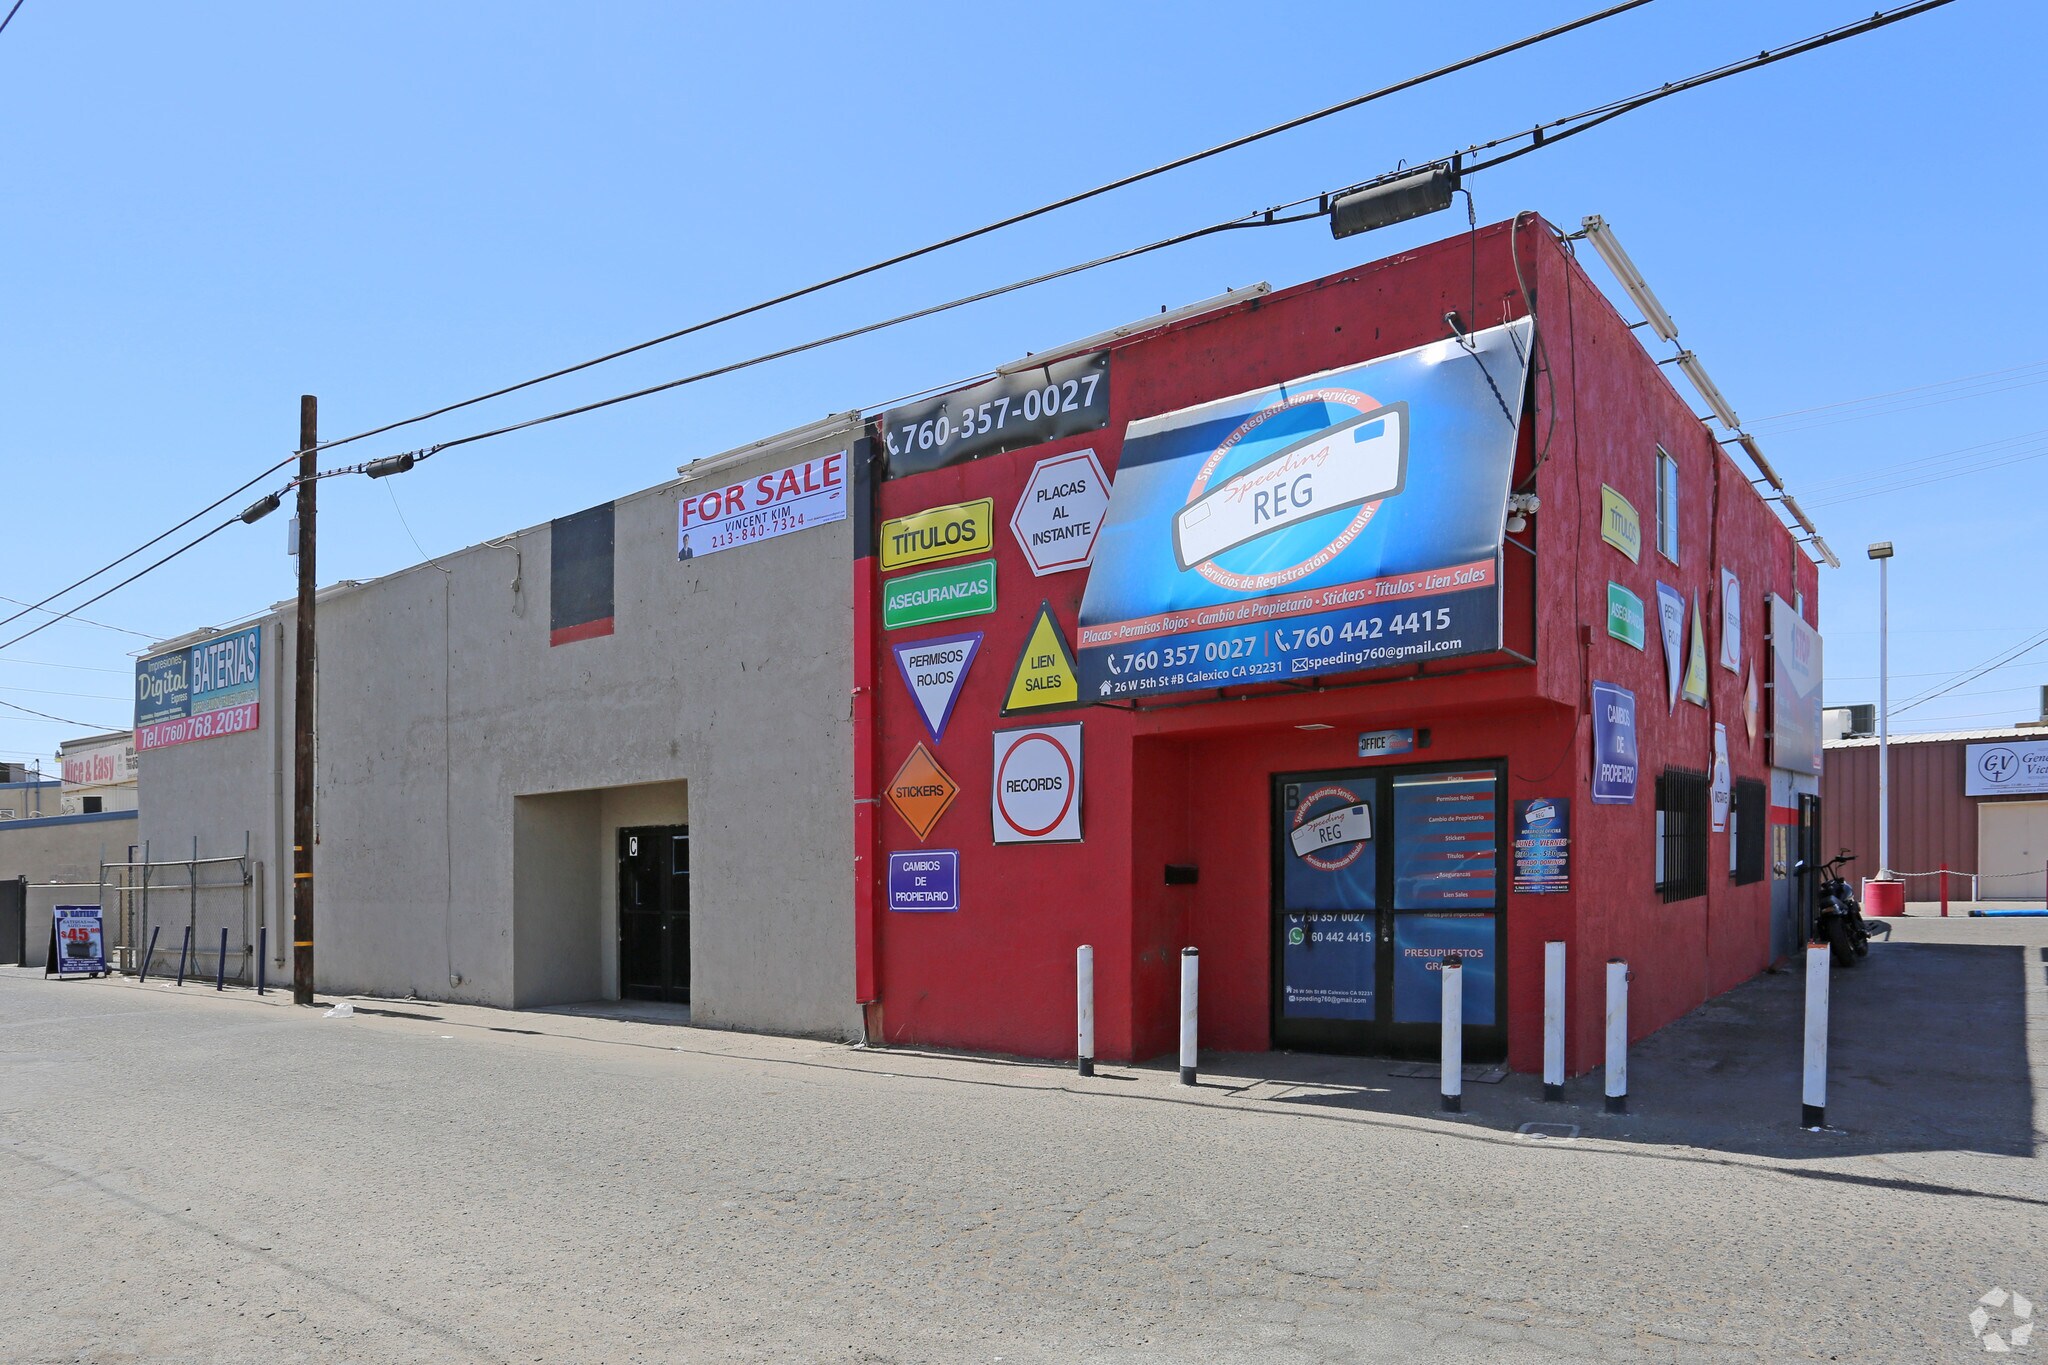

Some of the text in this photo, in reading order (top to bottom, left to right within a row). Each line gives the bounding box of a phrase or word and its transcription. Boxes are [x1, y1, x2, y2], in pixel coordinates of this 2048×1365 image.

[902, 373, 1101, 454] 760-357-0027
[1197, 389, 1360, 482] Speeding Registration Services
[1224, 445, 1330, 503] Speeding
[682, 454, 842, 527] FOR SALE
[1036, 479, 1086, 503] PLACAS
[1254, 473, 1313, 524] REG
[725, 512, 768, 533] VINCENT
[771, 505, 791, 521] KIM
[1052, 505, 1069, 521] AL
[711, 513, 805, 548] 213-840-7324
[1032, 522, 1091, 546] INSTANTE
[1611, 505, 1637, 546] TÍTULOS
[892, 519, 977, 556] TÍTULOS
[1200, 505, 1375, 589] Servicios de Registración Vehicular
[888, 578, 989, 611] ASEGURANZAS
[1082, 568, 1486, 643] Placas Permisos Rojos Cambio de Propietario Stickers Títulos Lien Sales
[1123, 608, 1451, 673] 760 357 0027 760 442 4415
[909, 649, 964, 668] PERMISOS
[1031, 654, 1055, 670] LIEN
[1308, 638, 1462, 669] speeding760@gmail.com
[148, 655, 182, 673] Impresiones
[193, 633, 256, 695] BATERIAS
[138, 660, 188, 705] Digital
[917, 671, 954, 687] ROJOS
[1025, 674, 1062, 693] SALES
[1114, 661, 1283, 692] 26 W 5th St #B Calexico CA 92231
[171, 692, 188, 705] Express
[142, 727, 160, 748] Tel.
[161, 721, 186, 744] (760)
[187, 706, 252, 740] 768.2031
[1361, 736, 1386, 750] OFFICE
[1616, 736, 1625, 754] DE
[64, 760, 84, 786] Nice
[85, 760, 92, 782] &
[93, 754, 114, 781] Easy
[1601, 764, 1635, 783] PROPIETARIO
[896, 784, 944, 799] STICKERS
[1006, 776, 1062, 793] RECORDS
[1286, 785, 1300, 811] B
[1295, 801, 1312, 823] Speeding
[1337, 788, 1356, 803] Services
[1436, 794, 1475, 803] Permisos Rojos
[1307, 813, 1345, 832] Speeding
[1455, 814, 1485, 823] Propietario
[1319, 824, 1342, 844] REG
[1540, 838, 1567, 846] VIERNES
[631, 838, 637, 855] C
[903, 860, 941, 872] CAMBIOS
[915, 876, 927, 887] DE
[895, 890, 949, 902] PROPIETARIO
[1321, 914, 1338, 922] 357
[1341, 914, 1365, 922] 0027
[1326, 932, 1344, 942] 442
[1347, 932, 1372, 943] 4415
[1404, 949, 1484, 957] PRESUPUESTOS
[1296, 995, 1367, 1004] speeding760@gmail.com
